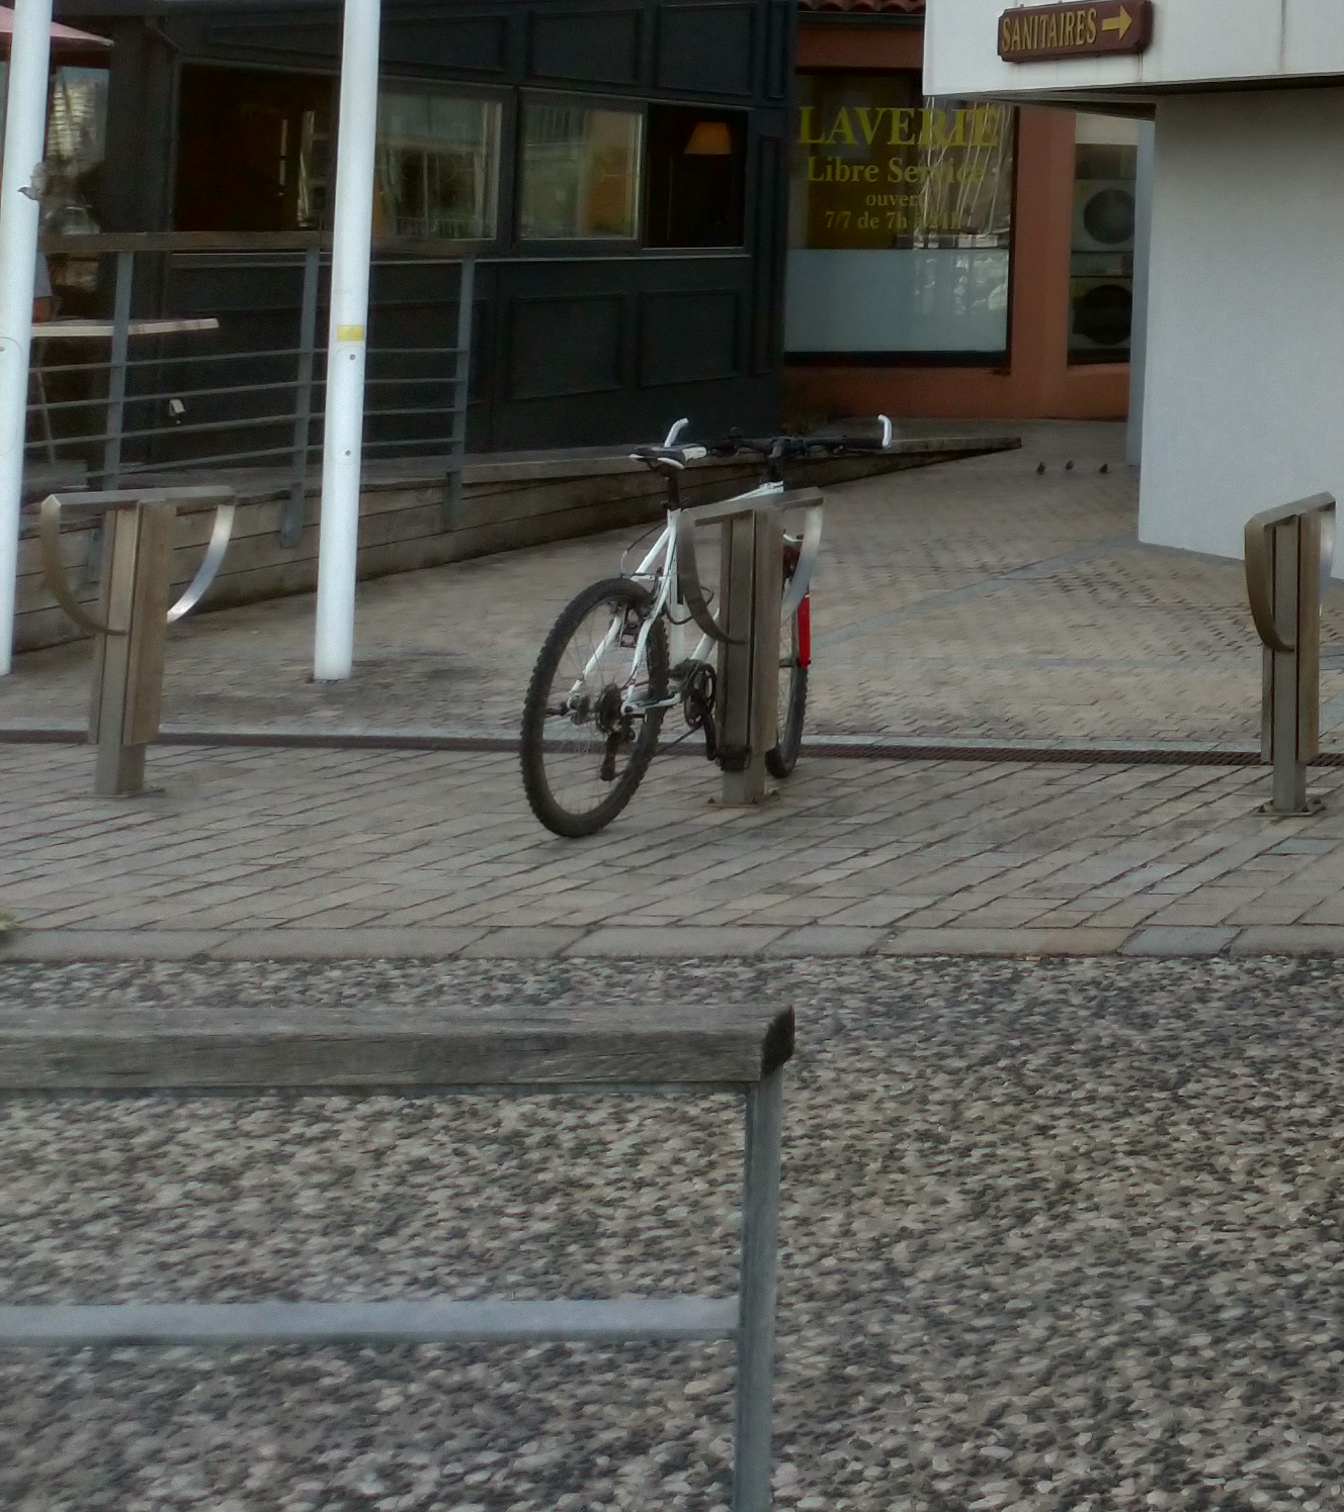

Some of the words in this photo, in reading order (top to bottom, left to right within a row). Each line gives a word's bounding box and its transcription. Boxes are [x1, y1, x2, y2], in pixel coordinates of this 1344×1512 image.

[1002, 8, 1097, 53] SANITAIRES
[799, 106, 1000, 147] LAVERIE
[807, 156, 879, 182] Libre
[825, 210, 851, 230] 7/7
[857, 210, 879, 230] de
[886, 210, 907, 230] 7h
